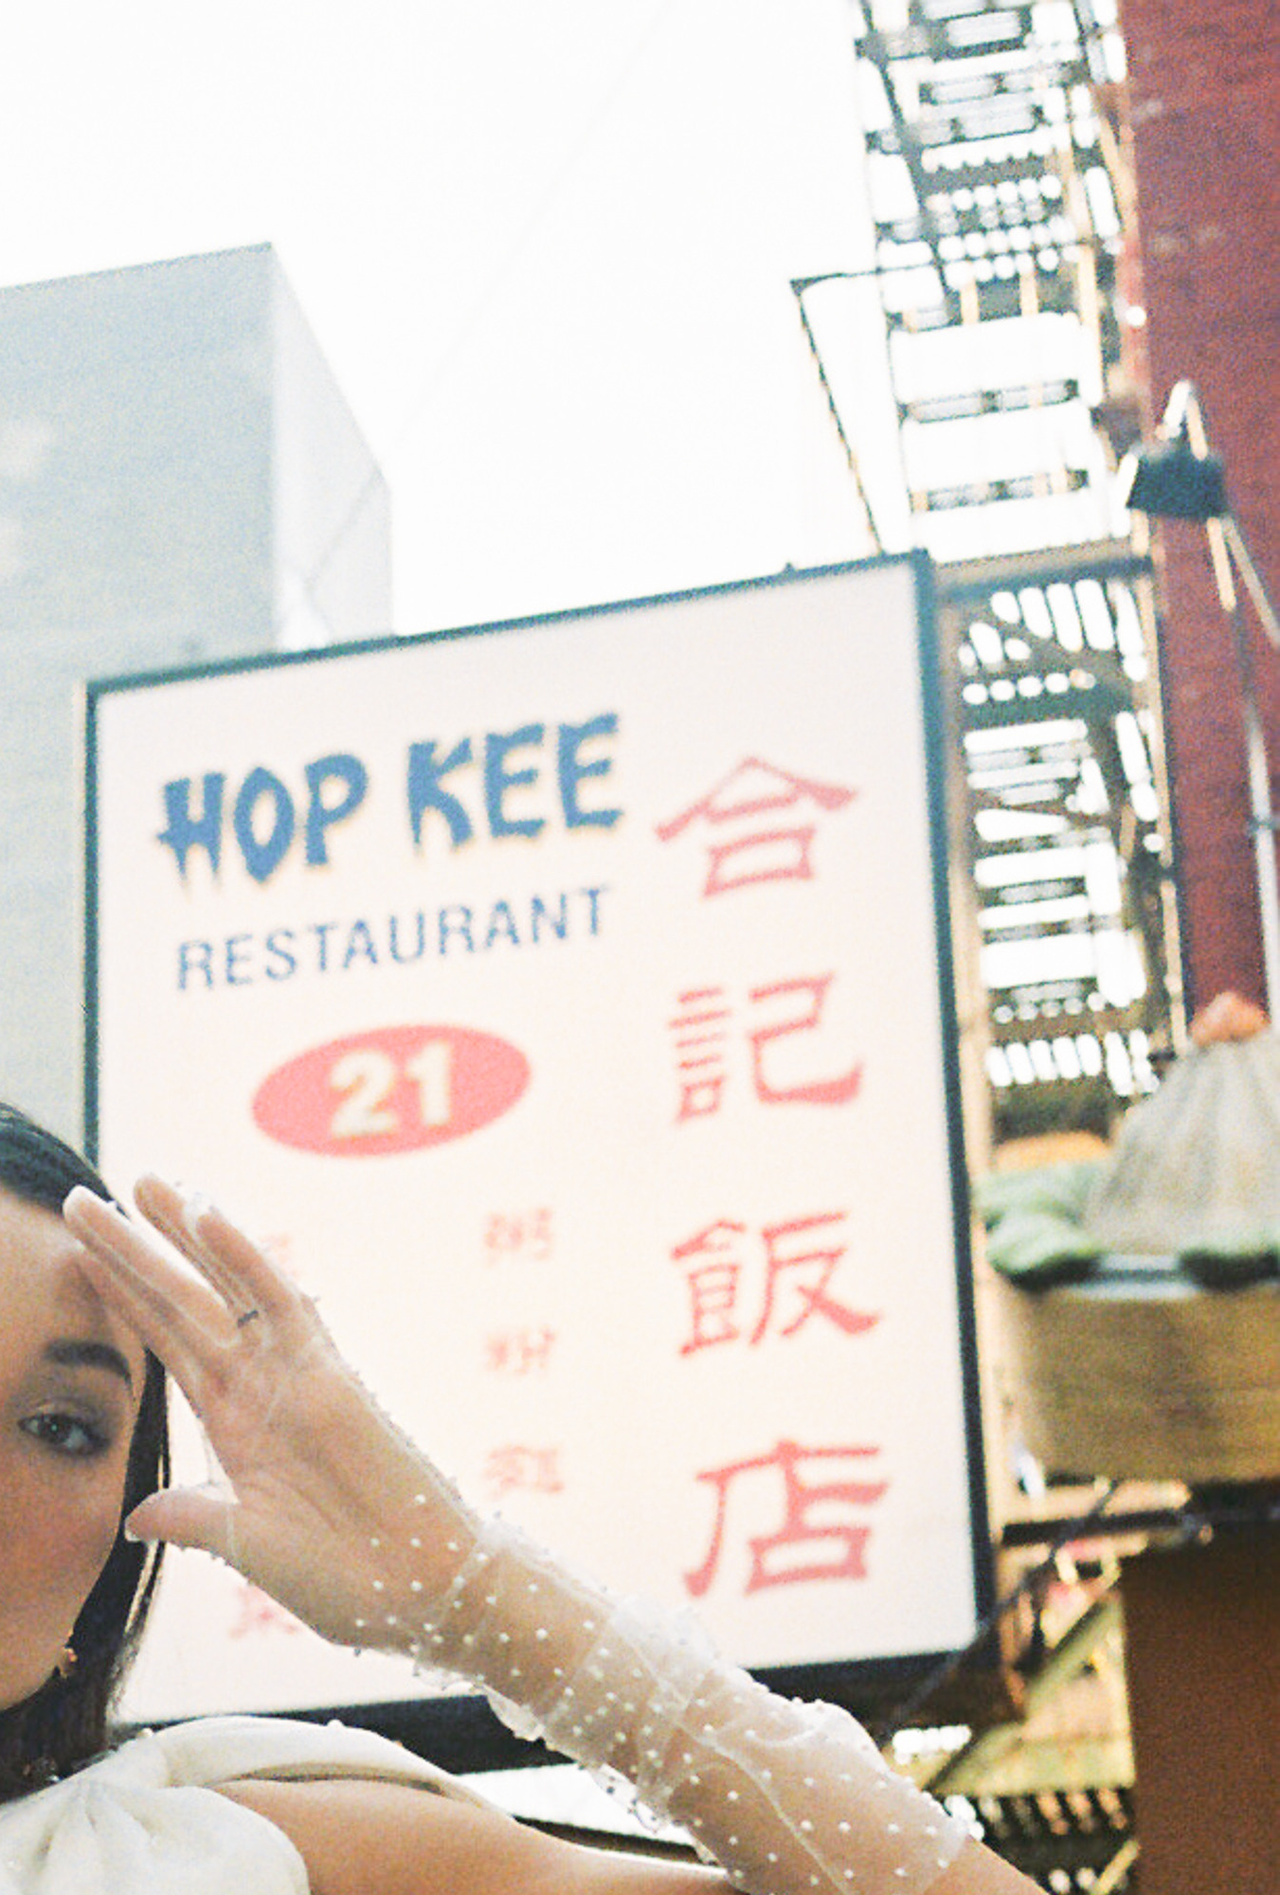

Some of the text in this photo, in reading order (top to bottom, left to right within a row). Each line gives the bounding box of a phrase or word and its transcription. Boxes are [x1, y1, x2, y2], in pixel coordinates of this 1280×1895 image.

[158, 712, 622, 896] HOP KEE
[177, 884, 611, 992] RESTAURANT
[328, 1049, 455, 1139] 21
[655, 755, 889, 1598] 合記飯店
